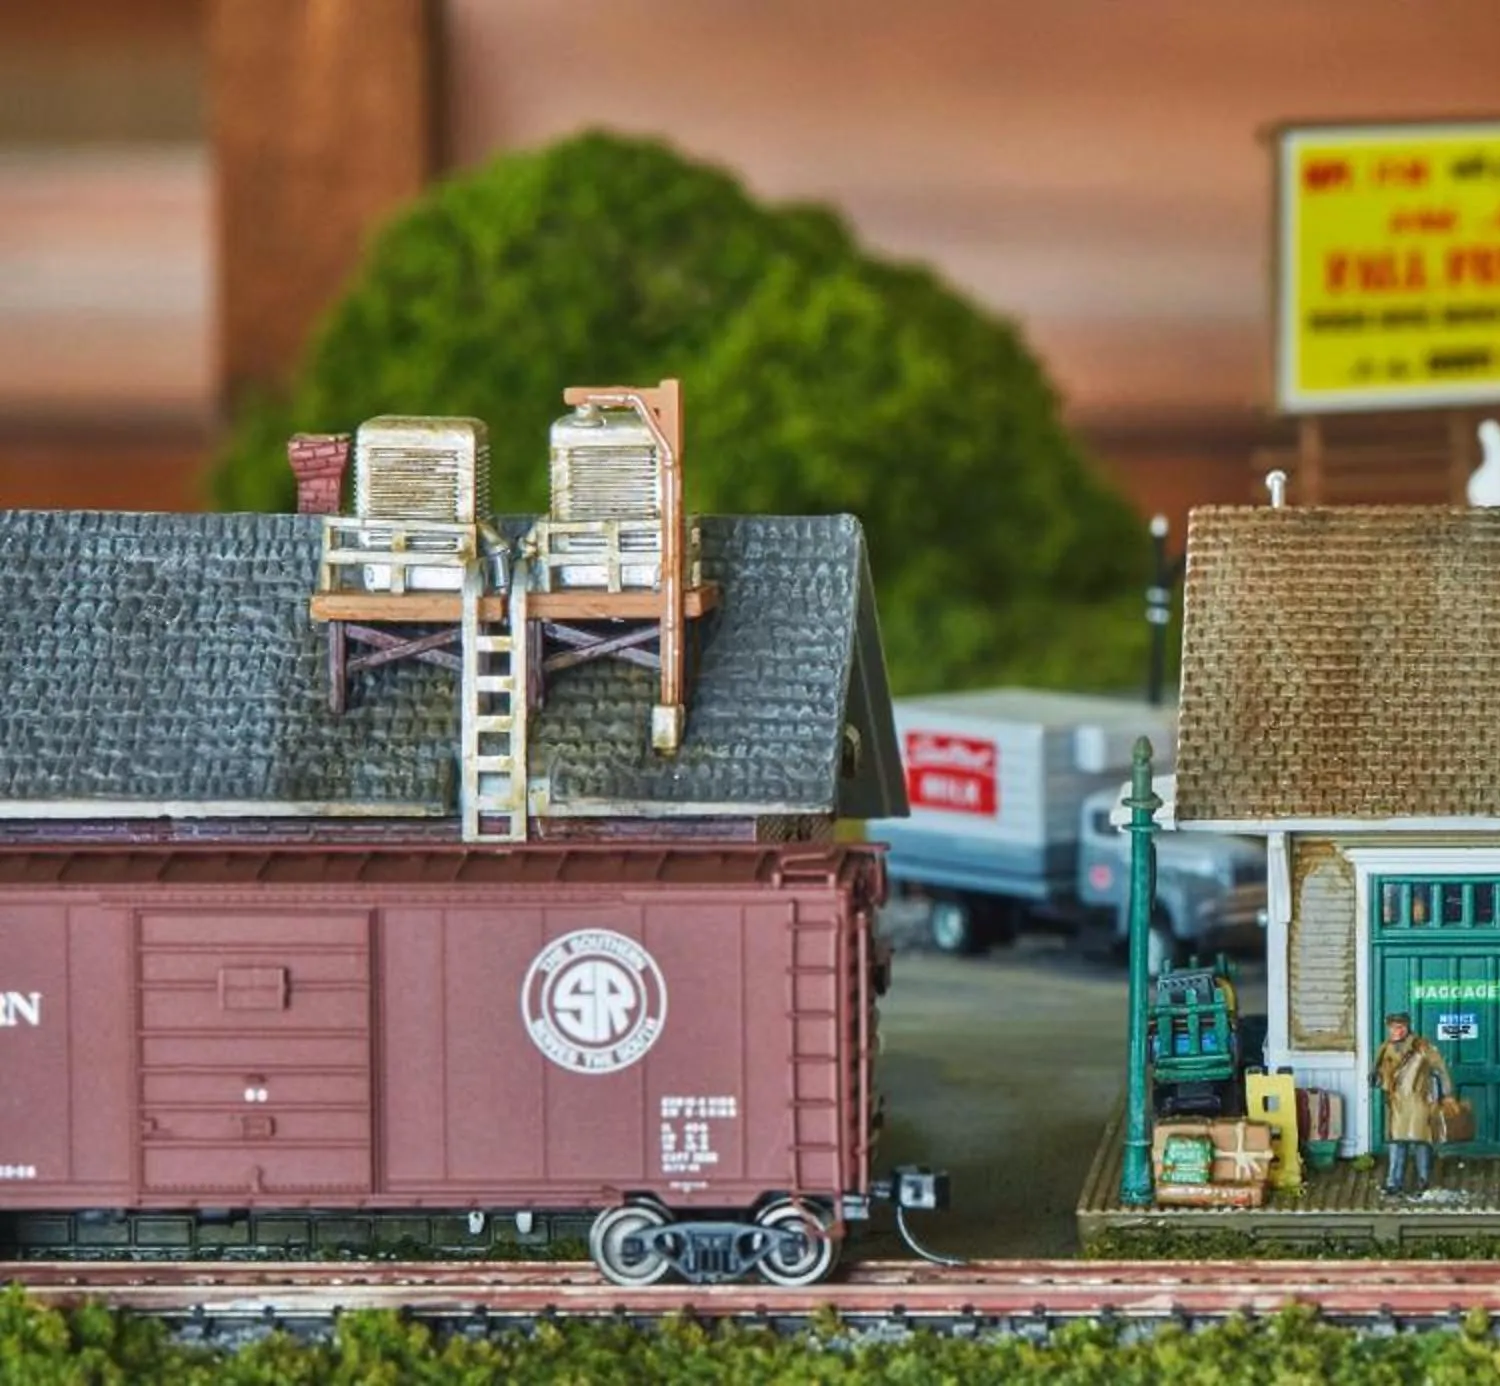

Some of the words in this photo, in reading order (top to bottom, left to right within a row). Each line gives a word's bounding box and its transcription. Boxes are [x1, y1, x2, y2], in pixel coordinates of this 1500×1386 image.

[1325, 248, 1427, 293] FALL
[568, 933, 649, 971] SOUTHERN
[553, 960, 637, 1042] SR
[1415, 984, 1497, 999] BAGGAGE
[615, 1016, 659, 1064] SOUTH
